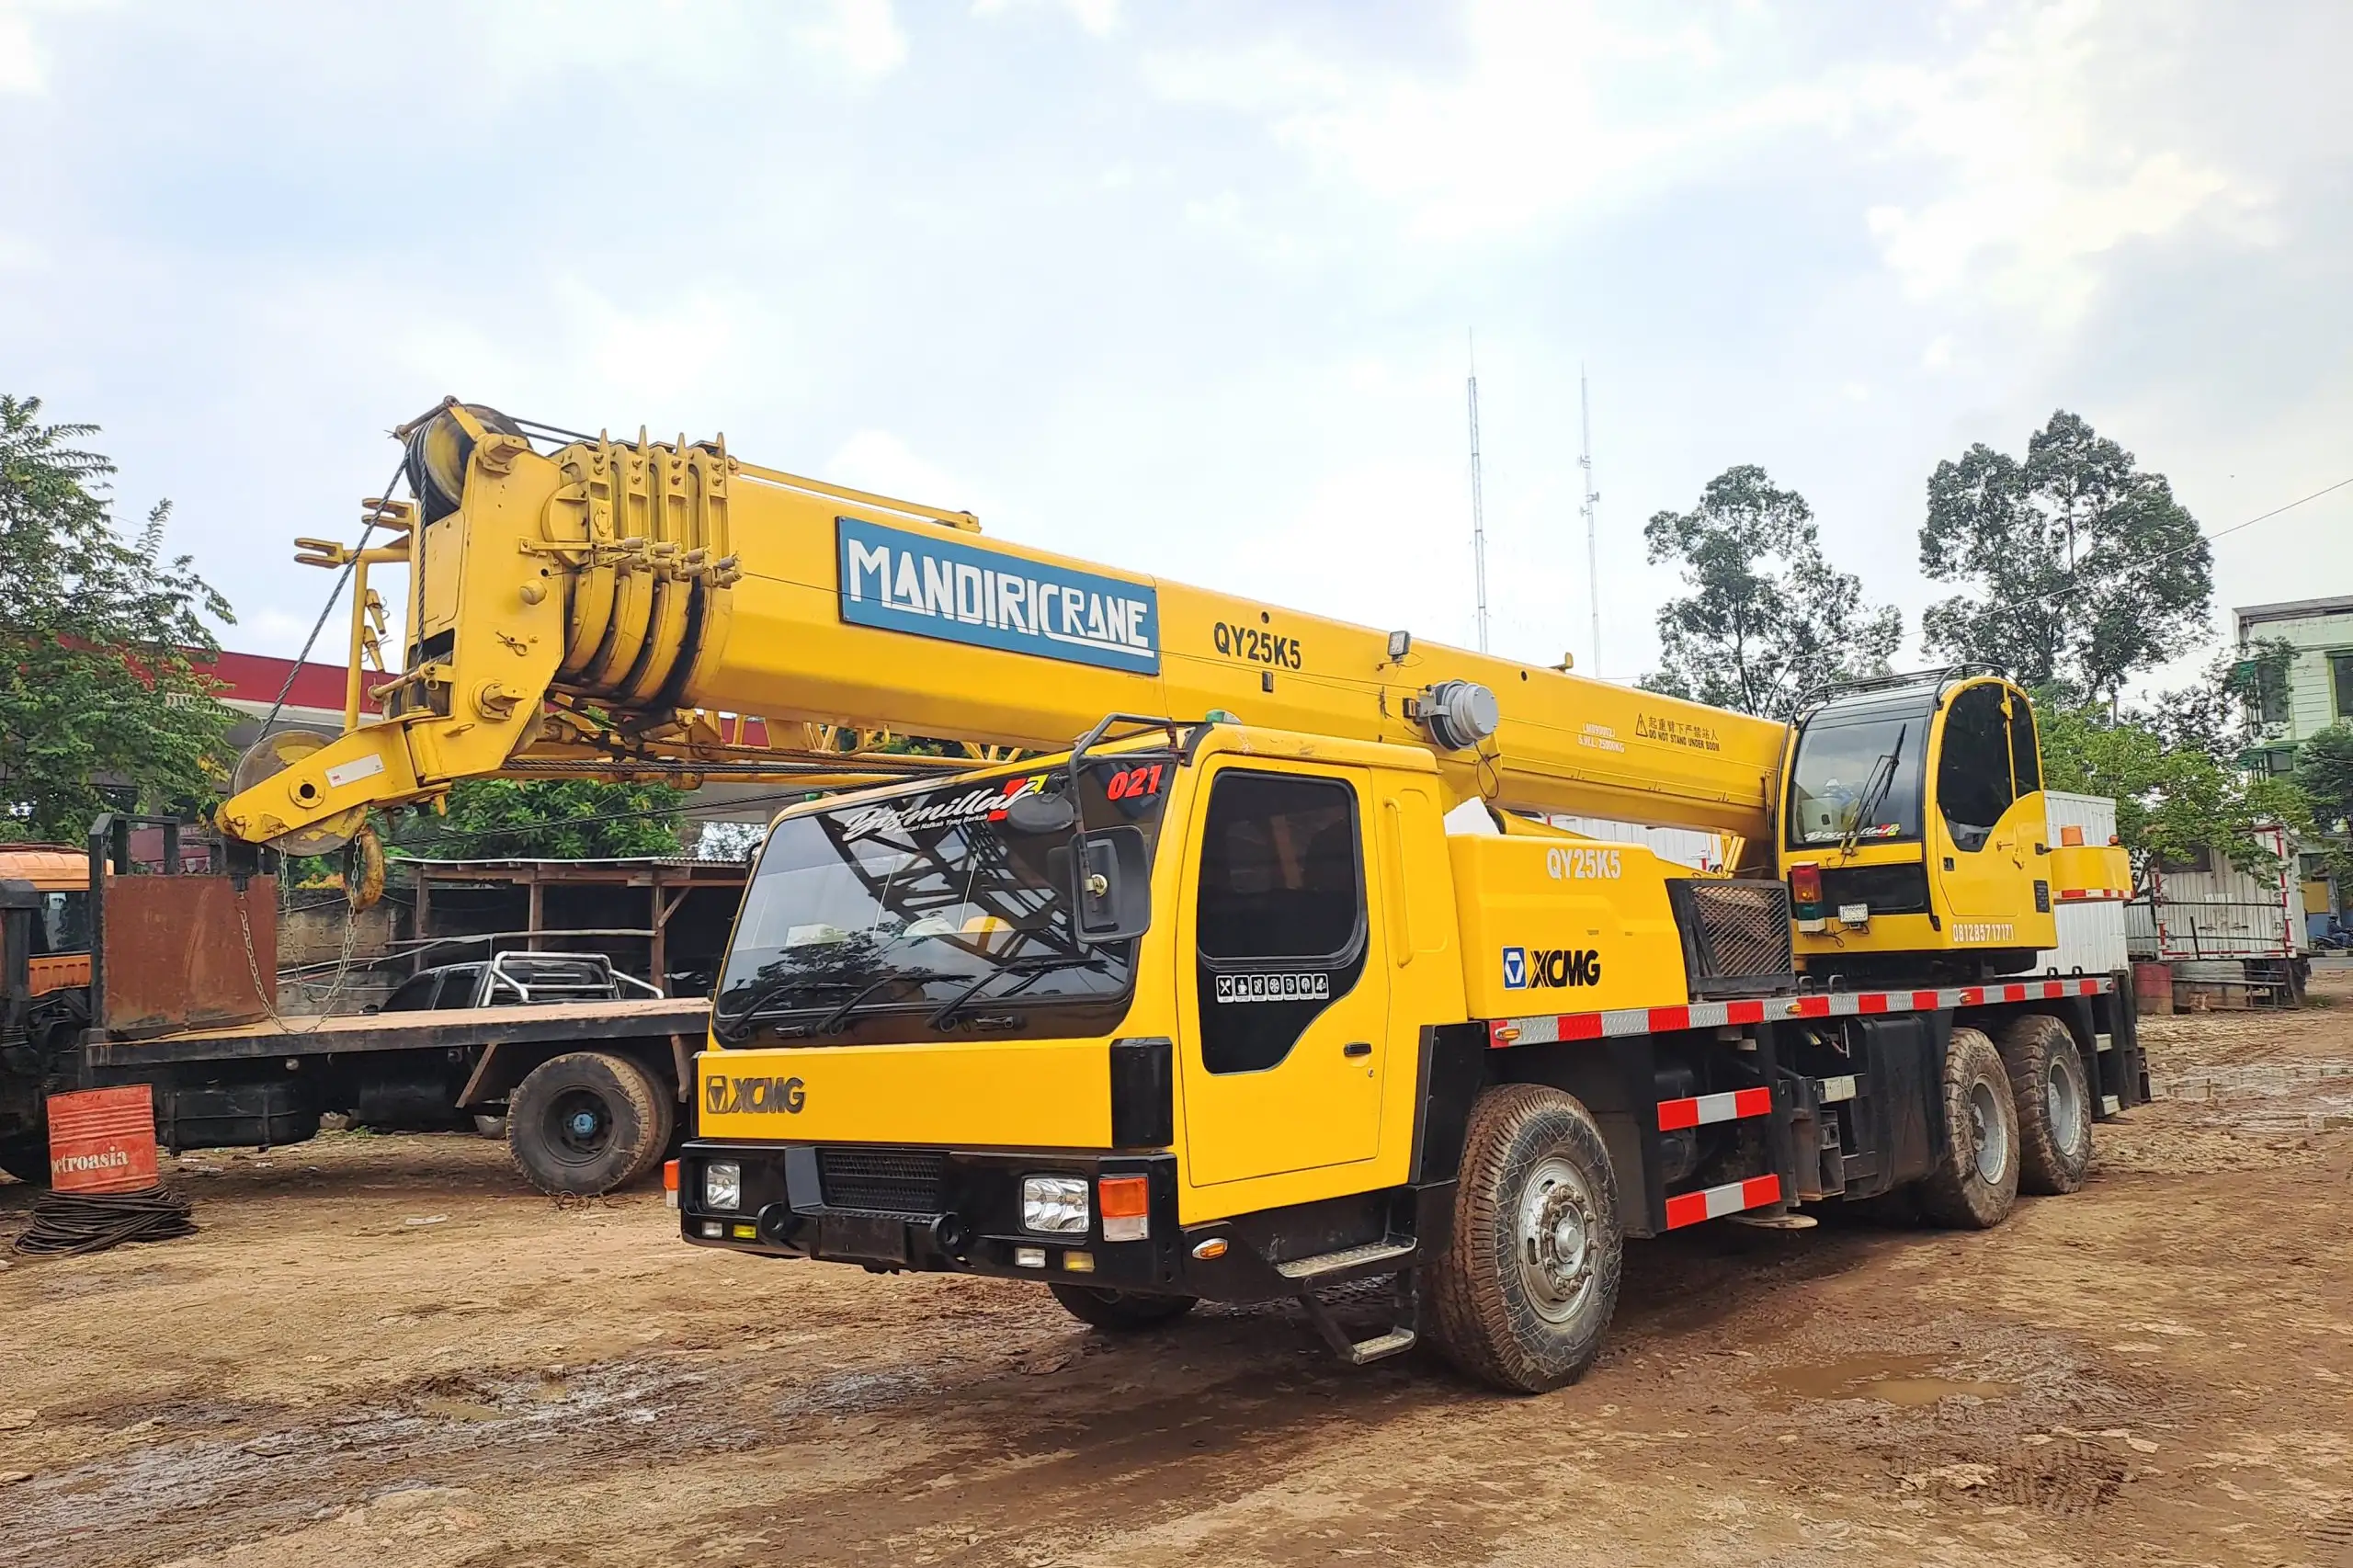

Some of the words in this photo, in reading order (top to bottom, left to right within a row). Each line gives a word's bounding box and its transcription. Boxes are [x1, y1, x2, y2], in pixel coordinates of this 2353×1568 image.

[1213, 620, 1302, 670] QY25K5
[1648, 729, 1657, 740] DO
[1658, 731, 1669, 743] NOT
[1670, 734, 1687, 746] STAND
[1688, 737, 1705, 750] UNDER
[1706, 741, 1721, 752] BOOM
[1108, 764, 1163, 801] 021
[1546, 847, 1622, 881] QY25K5
[1527, 949, 1601, 989] XCMG
[729, 1077, 806, 1114] XCMG
